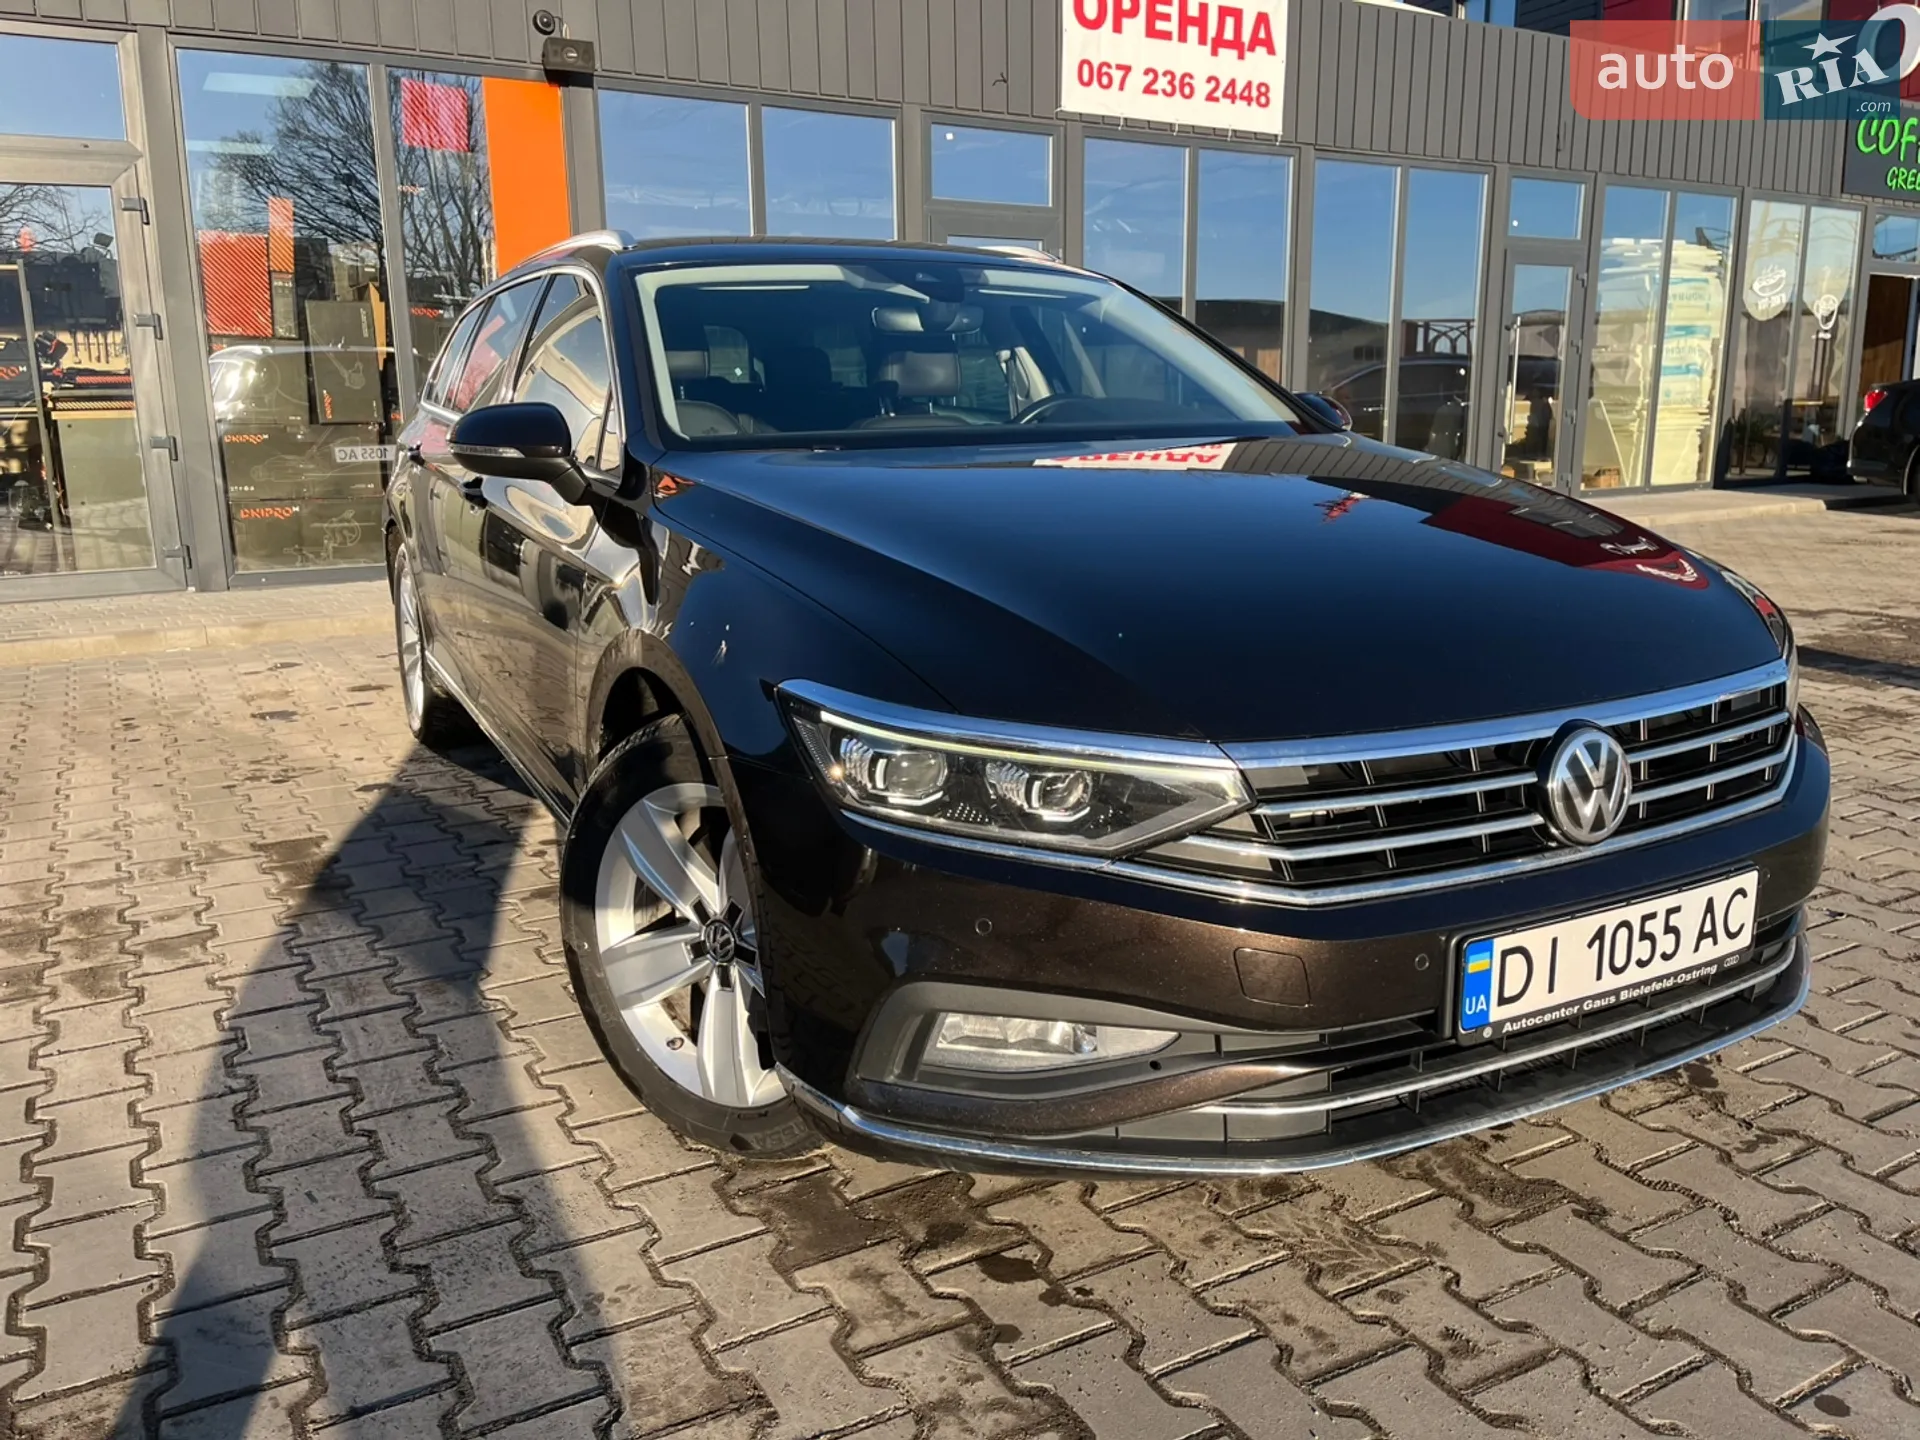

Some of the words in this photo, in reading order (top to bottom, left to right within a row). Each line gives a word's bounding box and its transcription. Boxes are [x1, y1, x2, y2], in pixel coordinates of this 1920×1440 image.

[1073, 0, 1277, 60] ОРЕНДА
[1077, 59, 1132, 92] 067
[1142, 67, 1195, 99] 236
[1205, 76, 1271, 108] 2448
[1856, 112, 1920, 163] COF
[1497, 937, 1558, 1007] DI
[1586, 905, 1682, 982] 1055
[1693, 887, 1748, 953] AC
[1465, 994, 1488, 1015] UA
[1501, 1004, 1580, 1033] Autocenter
[1583, 996, 1616, 1011] Gaus
[1619, 963, 1718, 1001] Bielefeld-Ostring
